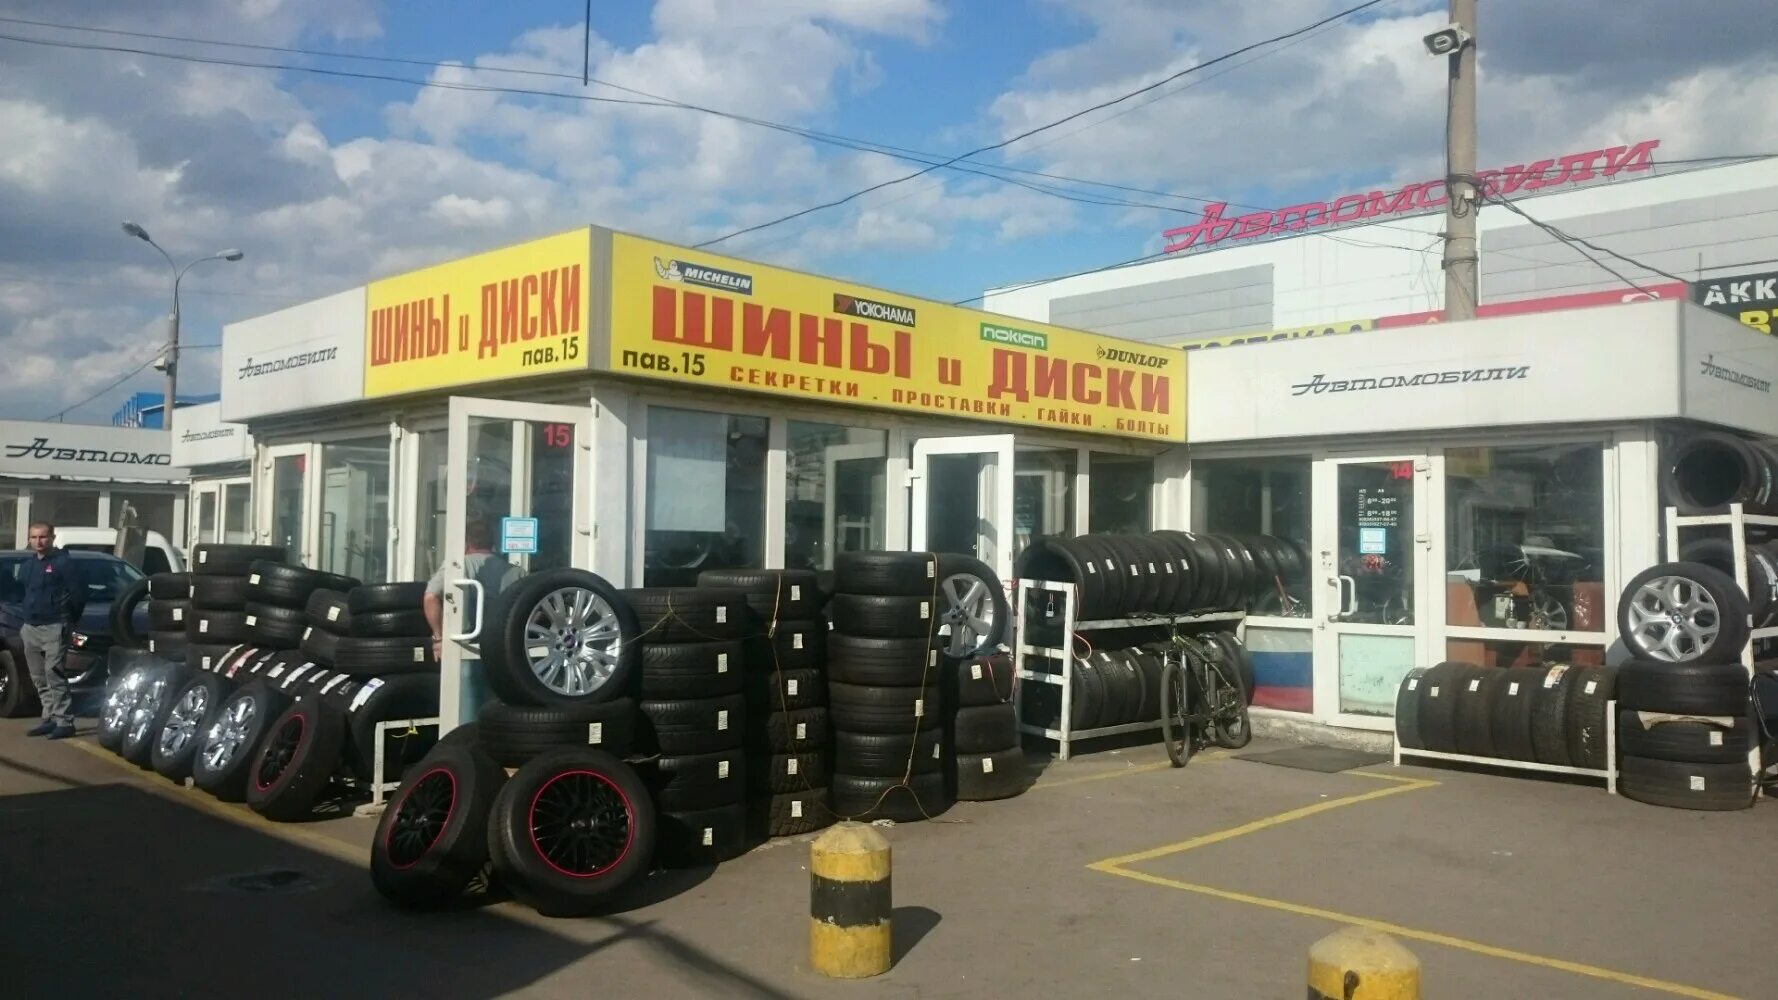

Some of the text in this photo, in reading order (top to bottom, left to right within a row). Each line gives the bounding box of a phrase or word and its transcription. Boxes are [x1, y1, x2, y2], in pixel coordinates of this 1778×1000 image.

[685, 266, 751, 289] MICHELIN
[370, 293, 450, 367] ШИНЫ
[477, 263, 581, 360] ДИСКИ
[854, 299, 915, 325] YOKOHAMA
[652, 284, 911, 379] ШИНЫ
[987, 347, 1170, 415] ДИСКИ
[1105, 348, 1169, 369] DUNLOP
[730, 366, 1169, 436] СЕКРЕТКИ ПРОСТАВКИ ГАЙКИ БОЛТЫ
[543, 424, 571, 448] 15
[1391, 462, 1412, 480] 14
